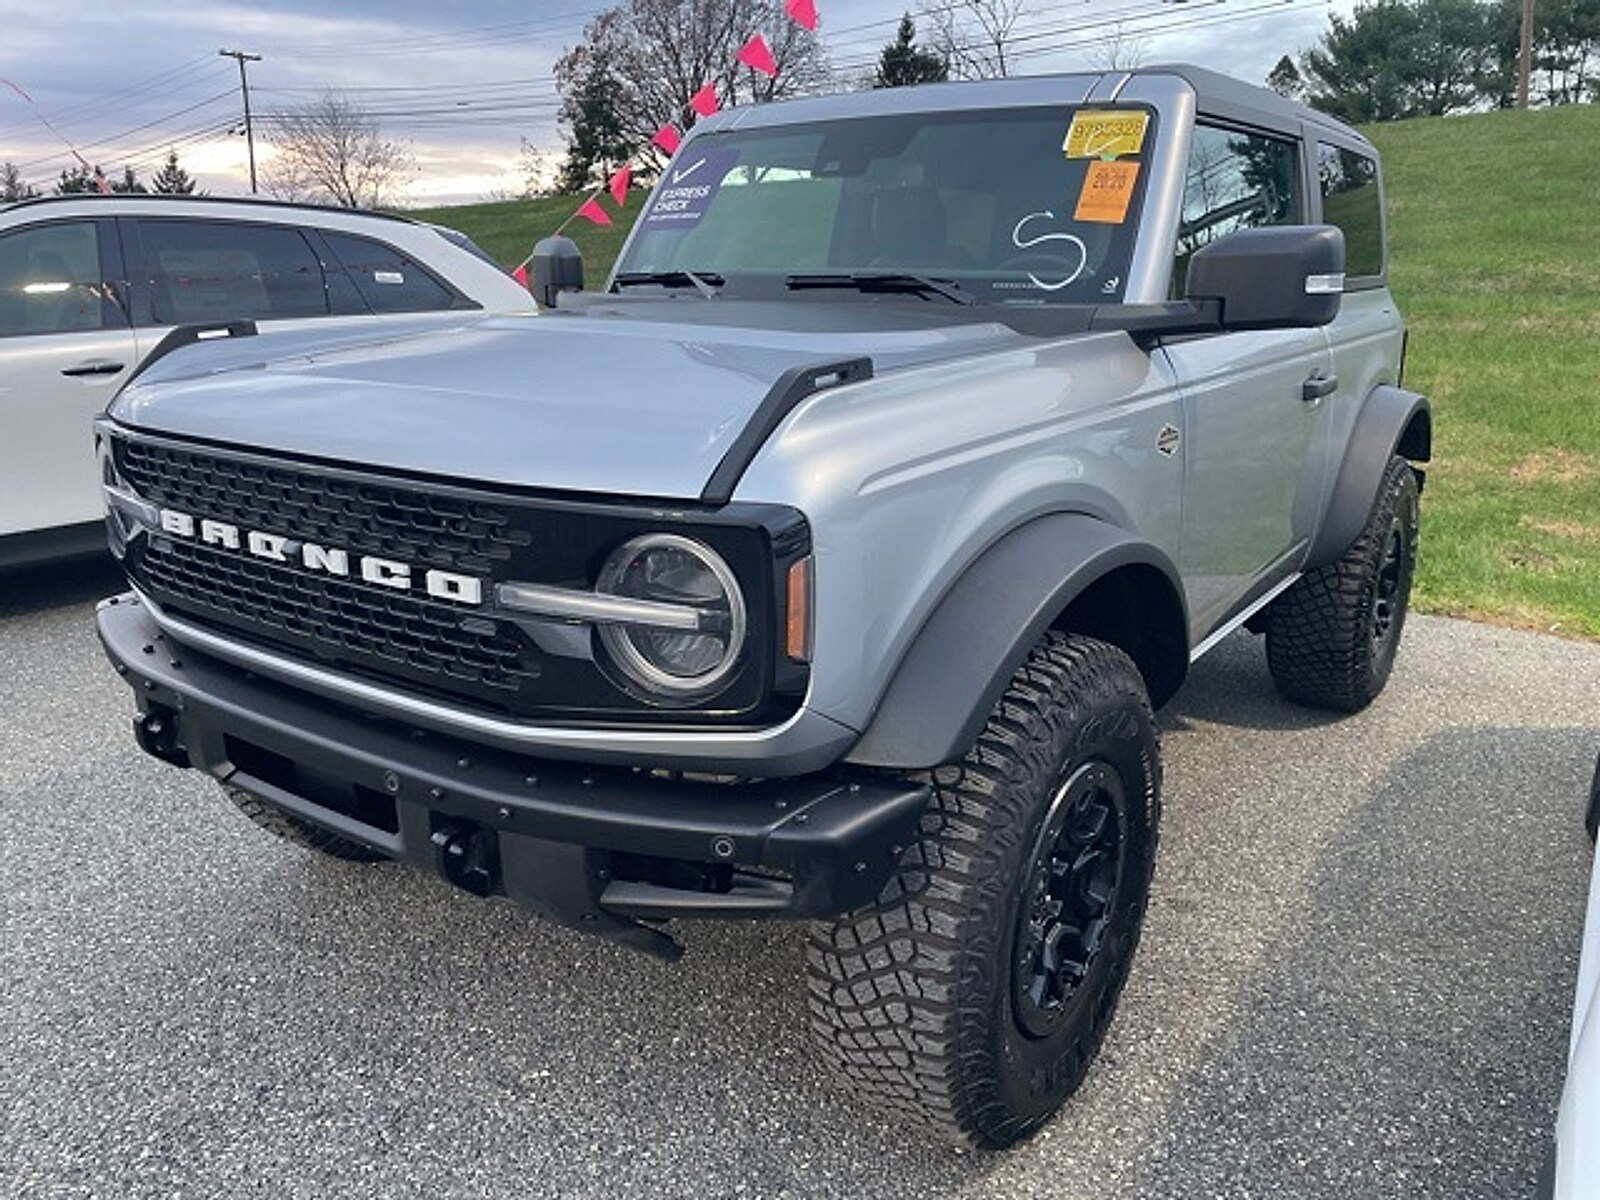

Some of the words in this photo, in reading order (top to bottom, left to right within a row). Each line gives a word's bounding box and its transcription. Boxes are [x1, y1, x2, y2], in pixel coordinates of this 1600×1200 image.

[653, 199, 690, 212] CHECK
[660, 185, 711, 199] EXPRESS
[1012, 210, 1087, 291] S
[160, 508, 482, 604] BRONCO
